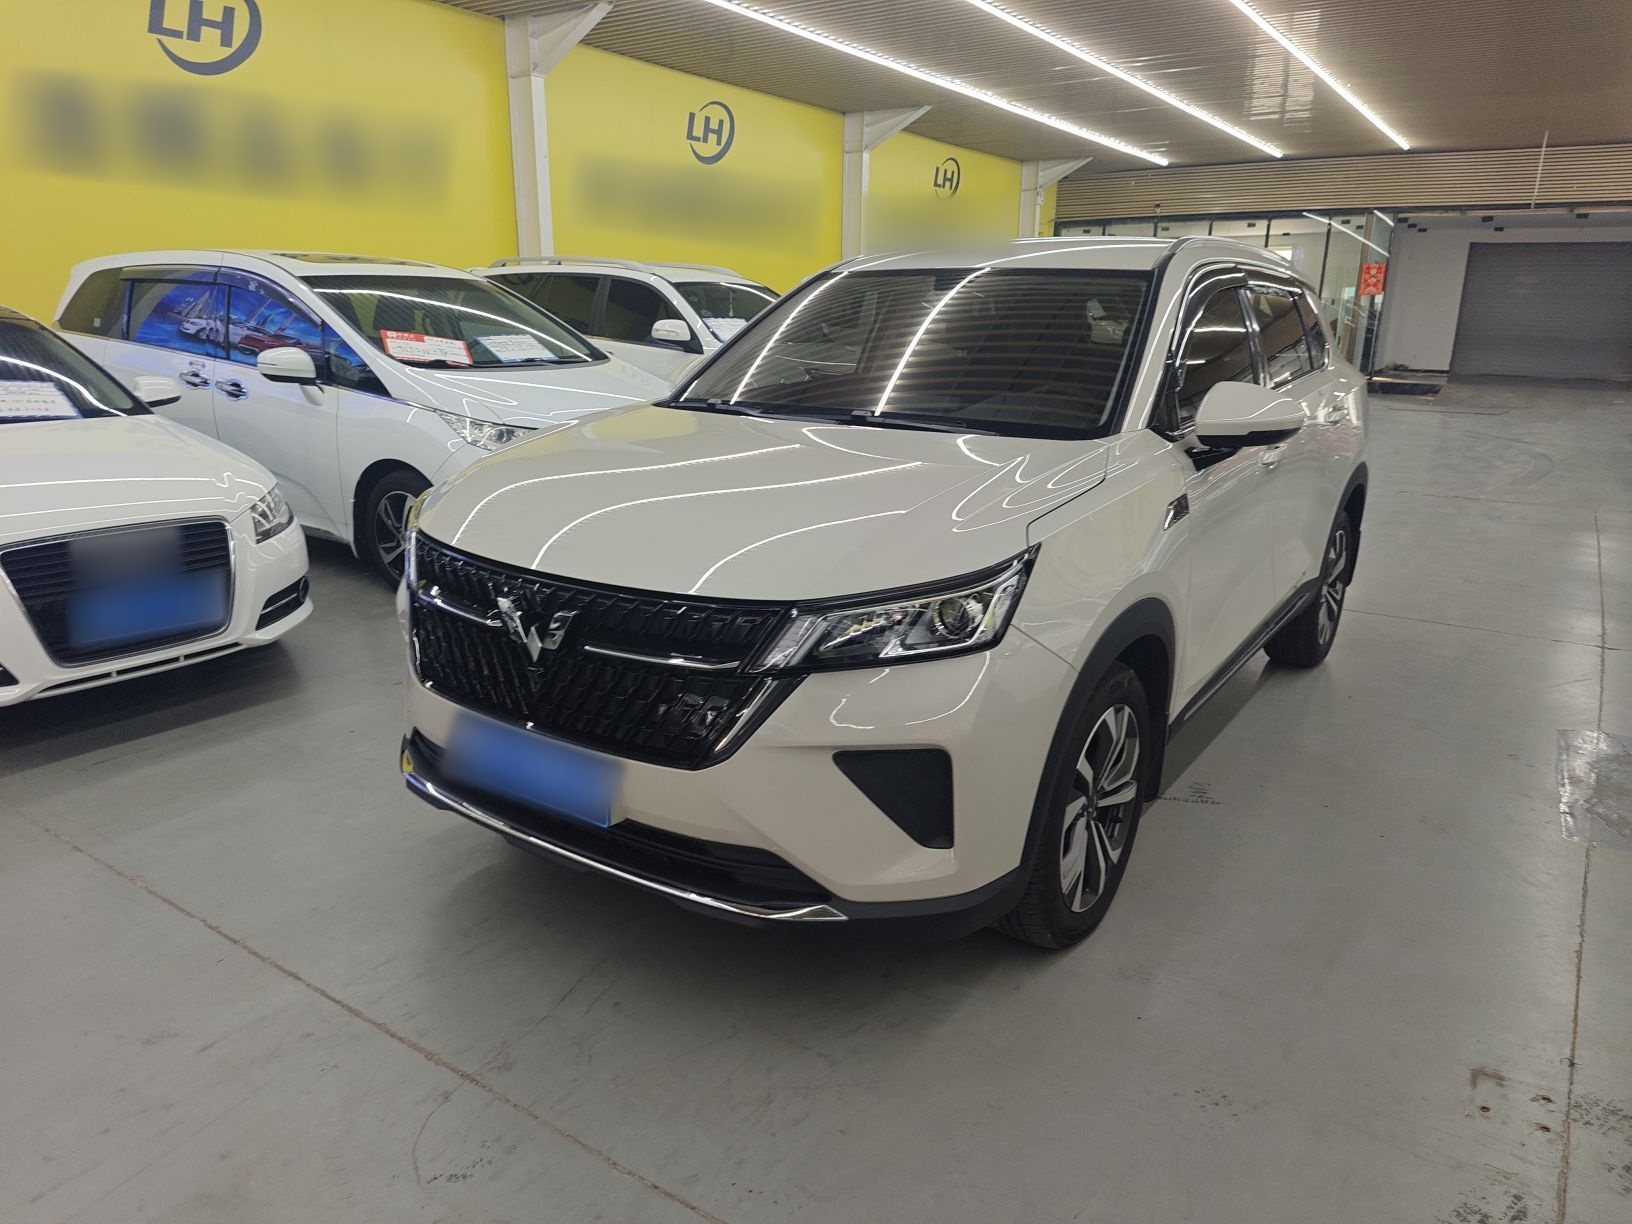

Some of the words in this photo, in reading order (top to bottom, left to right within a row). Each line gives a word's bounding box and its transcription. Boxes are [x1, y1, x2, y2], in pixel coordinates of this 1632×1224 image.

[148, 0, 235, 48] LH
[687, 111, 724, 147] LH
[934, 166, 955, 190] LH
